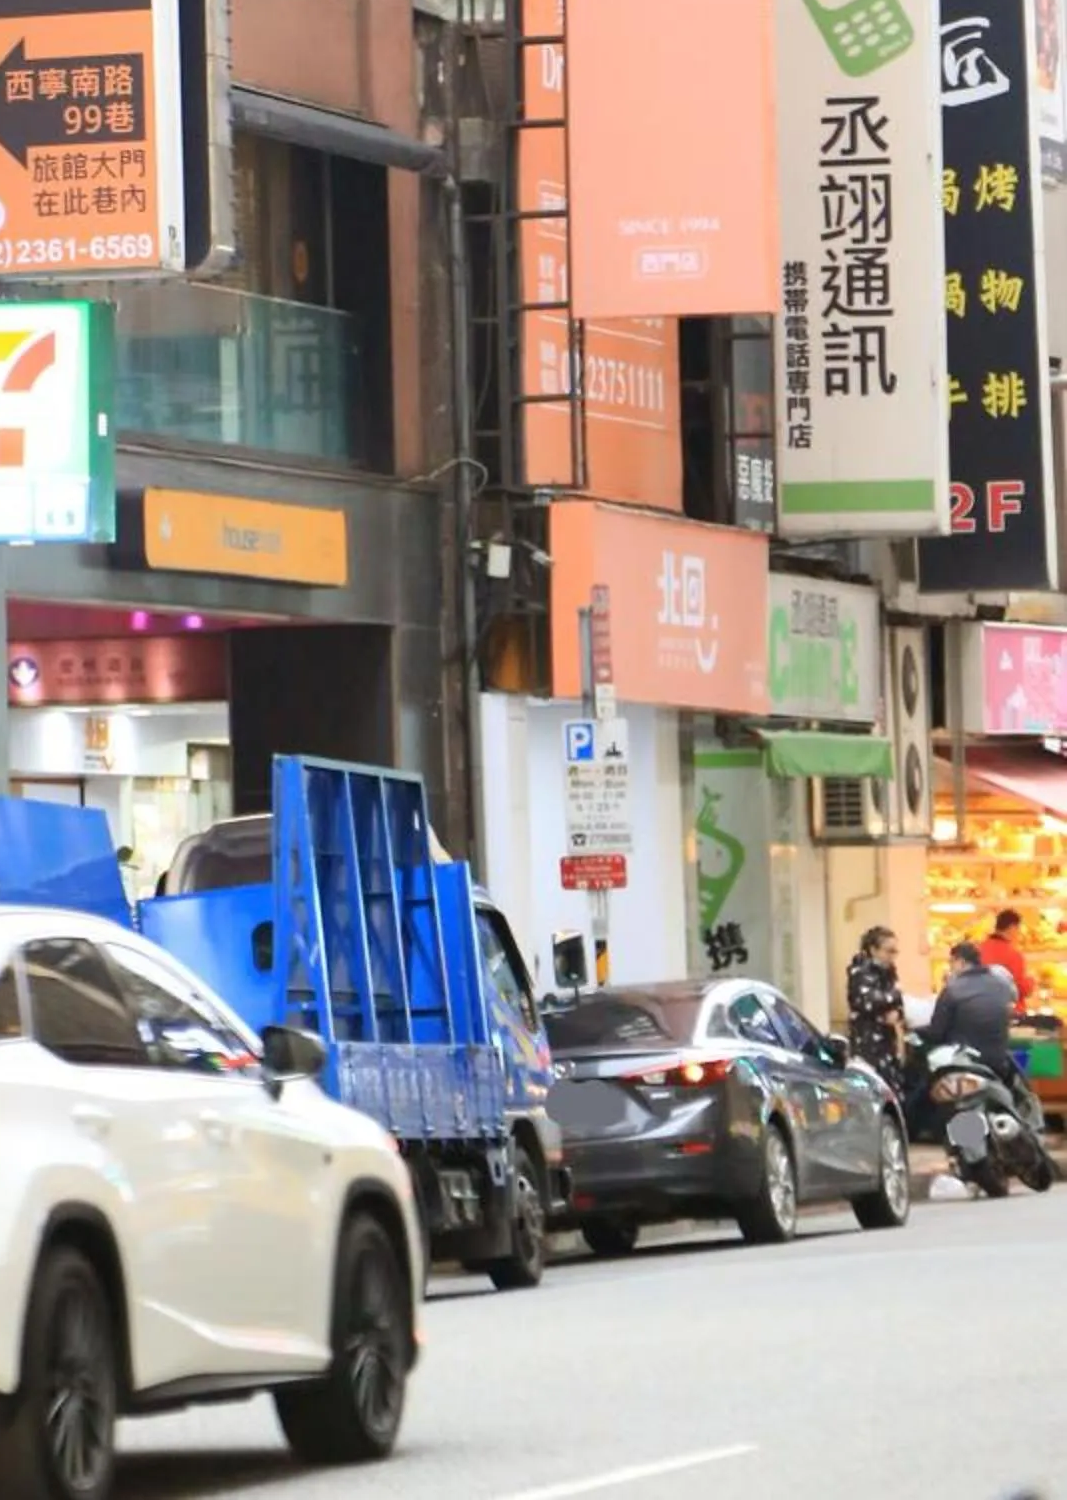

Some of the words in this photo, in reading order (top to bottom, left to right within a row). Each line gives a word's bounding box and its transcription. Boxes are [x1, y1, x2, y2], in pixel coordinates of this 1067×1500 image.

[5, 66, 134, 102] 西寧南路
[64, 103, 135, 135] 99巷
[33, 150, 147, 181] 旅館大門
[34, 187, 147, 218] 在此巷內
[819, 96, 897, 397] 丞翊通訊
[949, 480, 1025, 532] 2F
